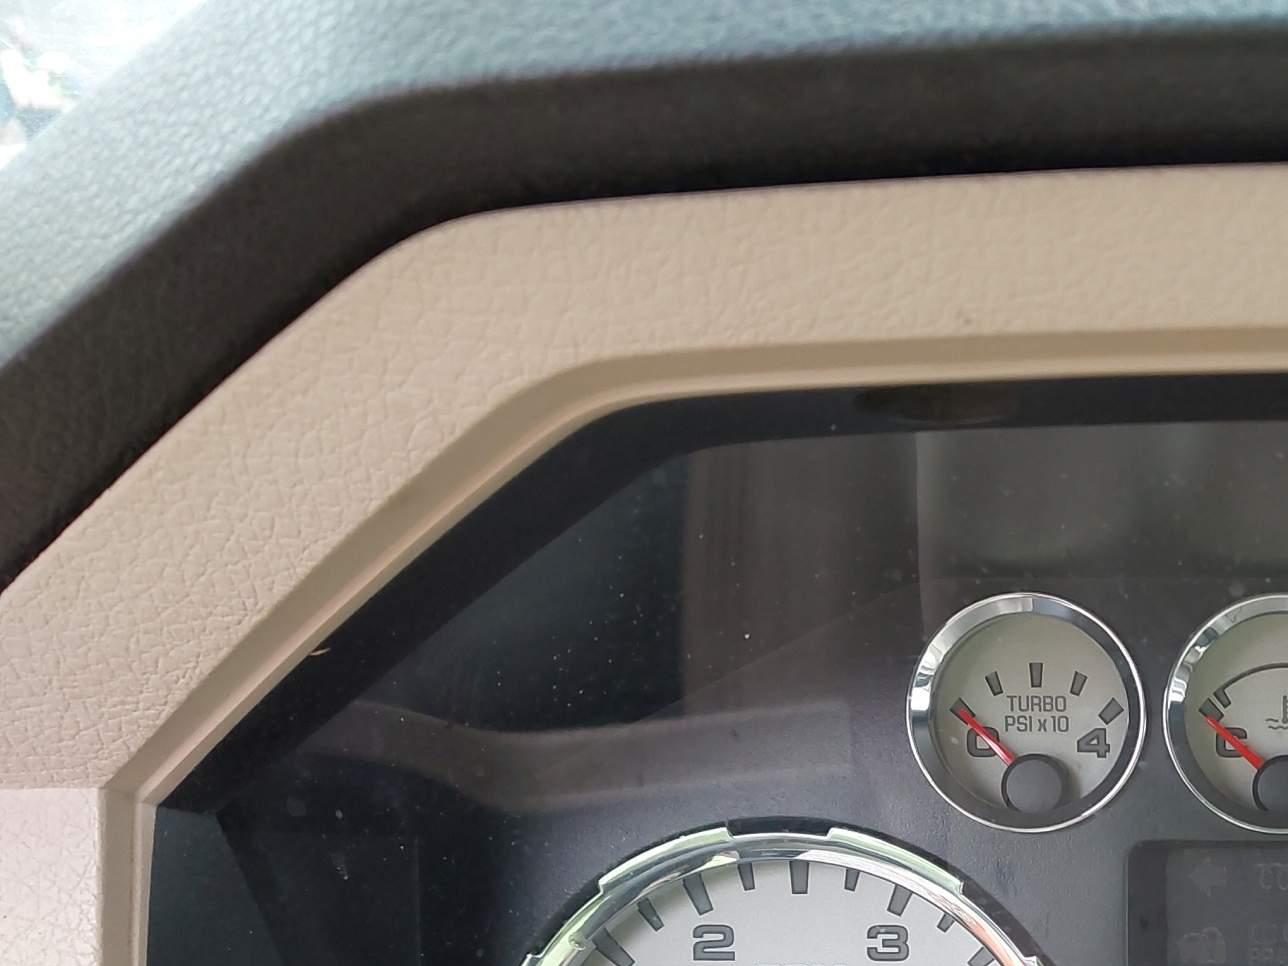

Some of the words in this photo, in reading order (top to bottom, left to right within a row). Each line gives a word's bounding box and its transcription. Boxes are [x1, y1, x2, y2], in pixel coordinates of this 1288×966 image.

[1007, 695, 1067, 713] TURBO
[1005, 715, 1034, 733] PSI
[1053, 715, 1069, 733] 10
[1077, 727, 1111, 758] 4
[1215, 727, 1248, 758] C
[692, 925, 736, 961] 2
[866, 925, 910, 961] 3
